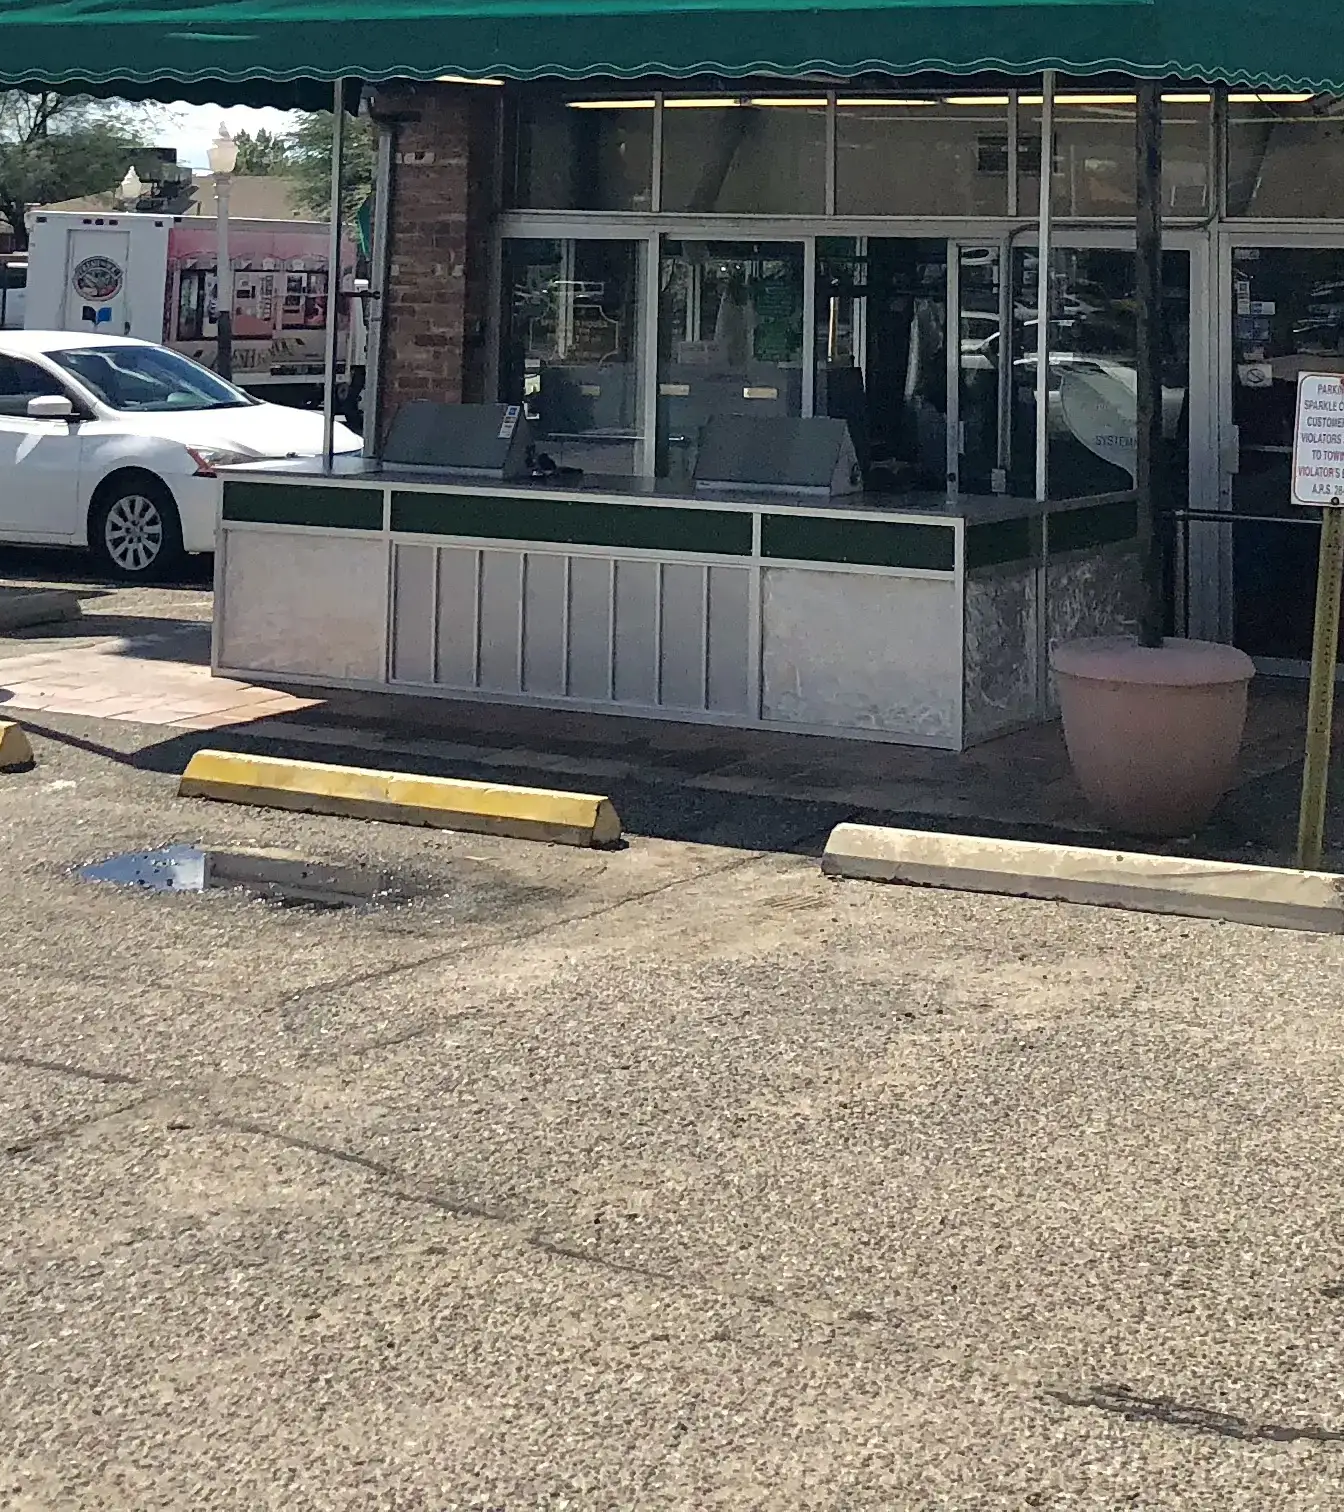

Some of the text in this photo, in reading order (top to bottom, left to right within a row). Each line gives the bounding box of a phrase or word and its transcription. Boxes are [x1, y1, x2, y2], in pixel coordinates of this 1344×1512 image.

[1304, 400, 1337, 411] SPARKLE
[1301, 433, 1341, 445] VIOLATORS
[1312, 450, 1322, 460] TO
[1298, 466, 1340, 479] VIOLATOR'S
